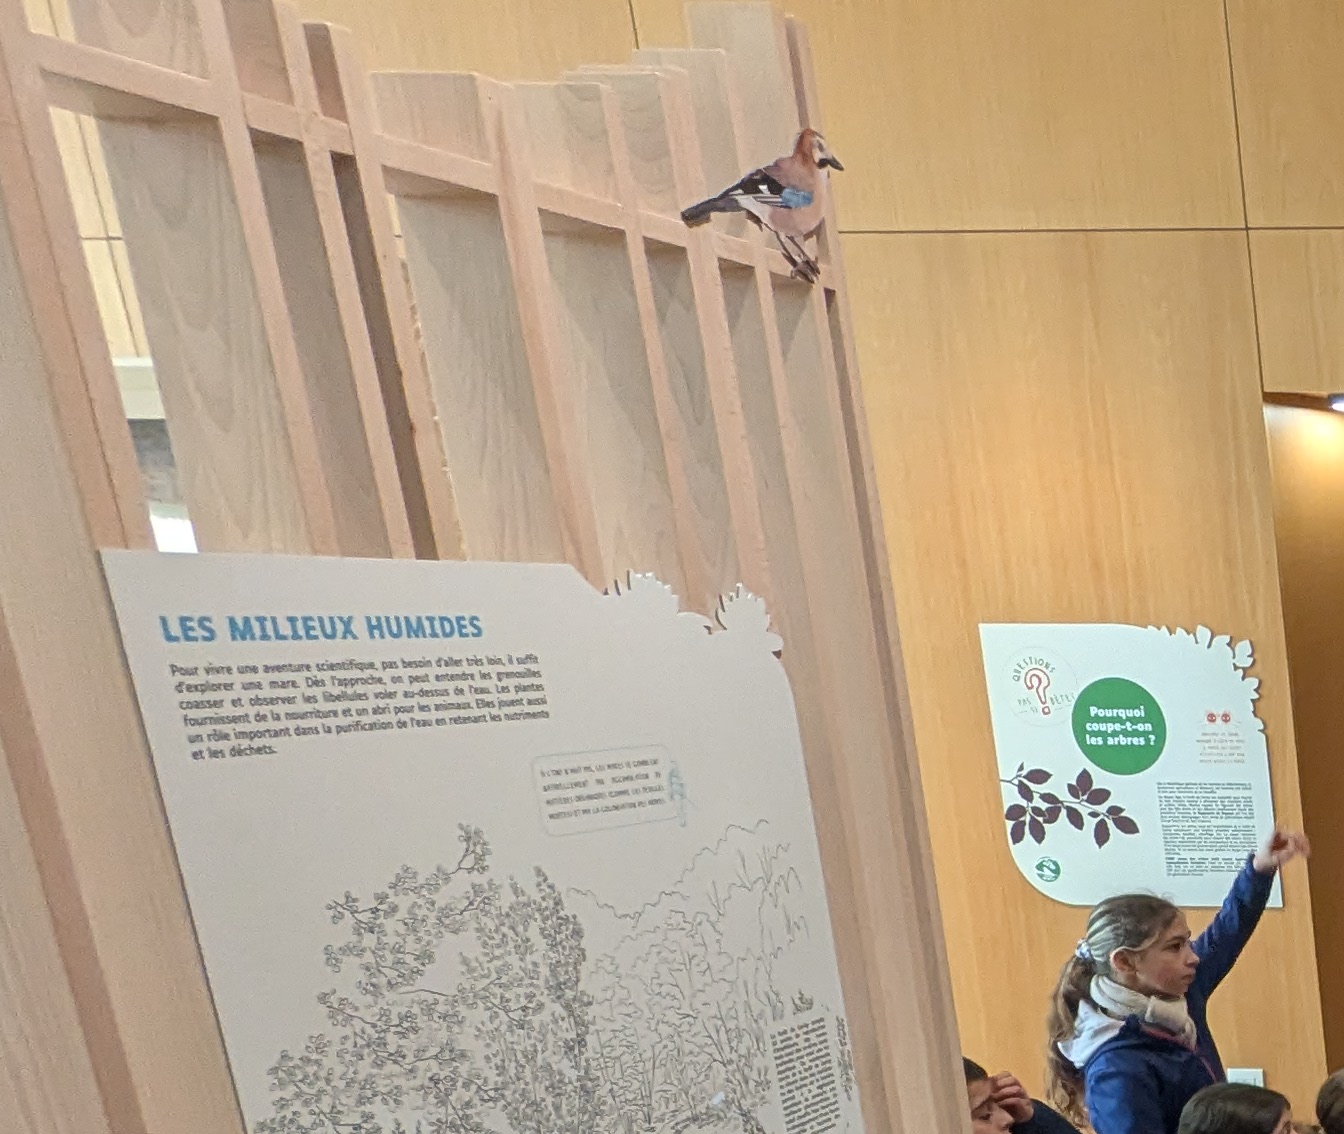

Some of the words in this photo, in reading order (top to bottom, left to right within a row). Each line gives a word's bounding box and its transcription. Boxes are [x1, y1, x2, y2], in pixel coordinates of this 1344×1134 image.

[160, 615, 216, 642] LES
[226, 615, 359, 641] MILIEUX
[365, 615, 483, 640] HUMIDES
[170, 663, 198, 677] Pour
[203, 662, 232, 676] vivre
[236, 664, 259, 674] une
[262, 663, 311, 674] aventure
[315, 658, 378, 673] scientifique,
[381, 660, 399, 672] pas
[401, 656, 433, 669] besoin
[435, 656, 463, 668] d'aller
[465, 654, 484, 667] très
[507, 653, 513, 666] il
[174, 680, 234, 695] d'explorer
[241, 680, 263, 691] une
[269, 680, 300, 690] mare.
[305, 675, 326, 689] Dès
[330, 674, 387, 689] l'approche,
[391, 675, 404, 684] on
[408, 673, 430, 686] peut
[435, 671, 475, 683] entendre
[479, 669, 492, 681] les
[496, 667, 542, 682] grenouilles
[179, 698, 224, 710] coasser
[230, 697, 244, 708] et
[249, 694, 297, 707] observer
[302, 692, 318, 705] les
[322, 690, 369, 703] libellules
[373, 689, 398, 700] voler
[403, 687, 450, 699] au-dessus
[453, 685, 465, 697] de
[495, 684, 510, 694] Les
[514, 682, 545, 695] plantes
[183, 712, 251, 727] fournissent
[254, 711, 268, 724] de
[270, 710, 281, 722] la
[284, 707, 338, 720] nourriture
[342, 707, 354, 718] et
[355, 707, 368, 717] un
[371, 703, 391, 715] abri
[393, 704, 415, 716] pour
[418, 702, 432, 713] les
[475, 698, 496, 710] Elles
[497, 697, 525, 711] jouent
[526, 695, 548, 706] aussi
[1089, 706, 1145, 719] Pourquoi
[187, 733, 203, 744] un
[206, 728, 230, 742] rôle
[233, 727, 292, 742] important
[294, 724, 320, 736] dans
[322, 723, 332, 734] la
[335, 719, 394, 736] purification
[396, 718, 408, 730] de
[410, 717, 432, 728] l'eau
[435, 717, 447, 726] en
[449, 714, 488, 725] retenant
[489, 711, 502, 723] les
[504, 709, 550, 721] nutriments
[1086, 721, 1152, 733] coupe-t-on
[192, 749, 205, 761] et
[208, 746, 226, 759] les
[229, 743, 277, 757] déchets.
[1086, 734, 1103, 745] les
[1107, 734, 1146, 745] arbres
[1149, 735, 1156, 745] ?
